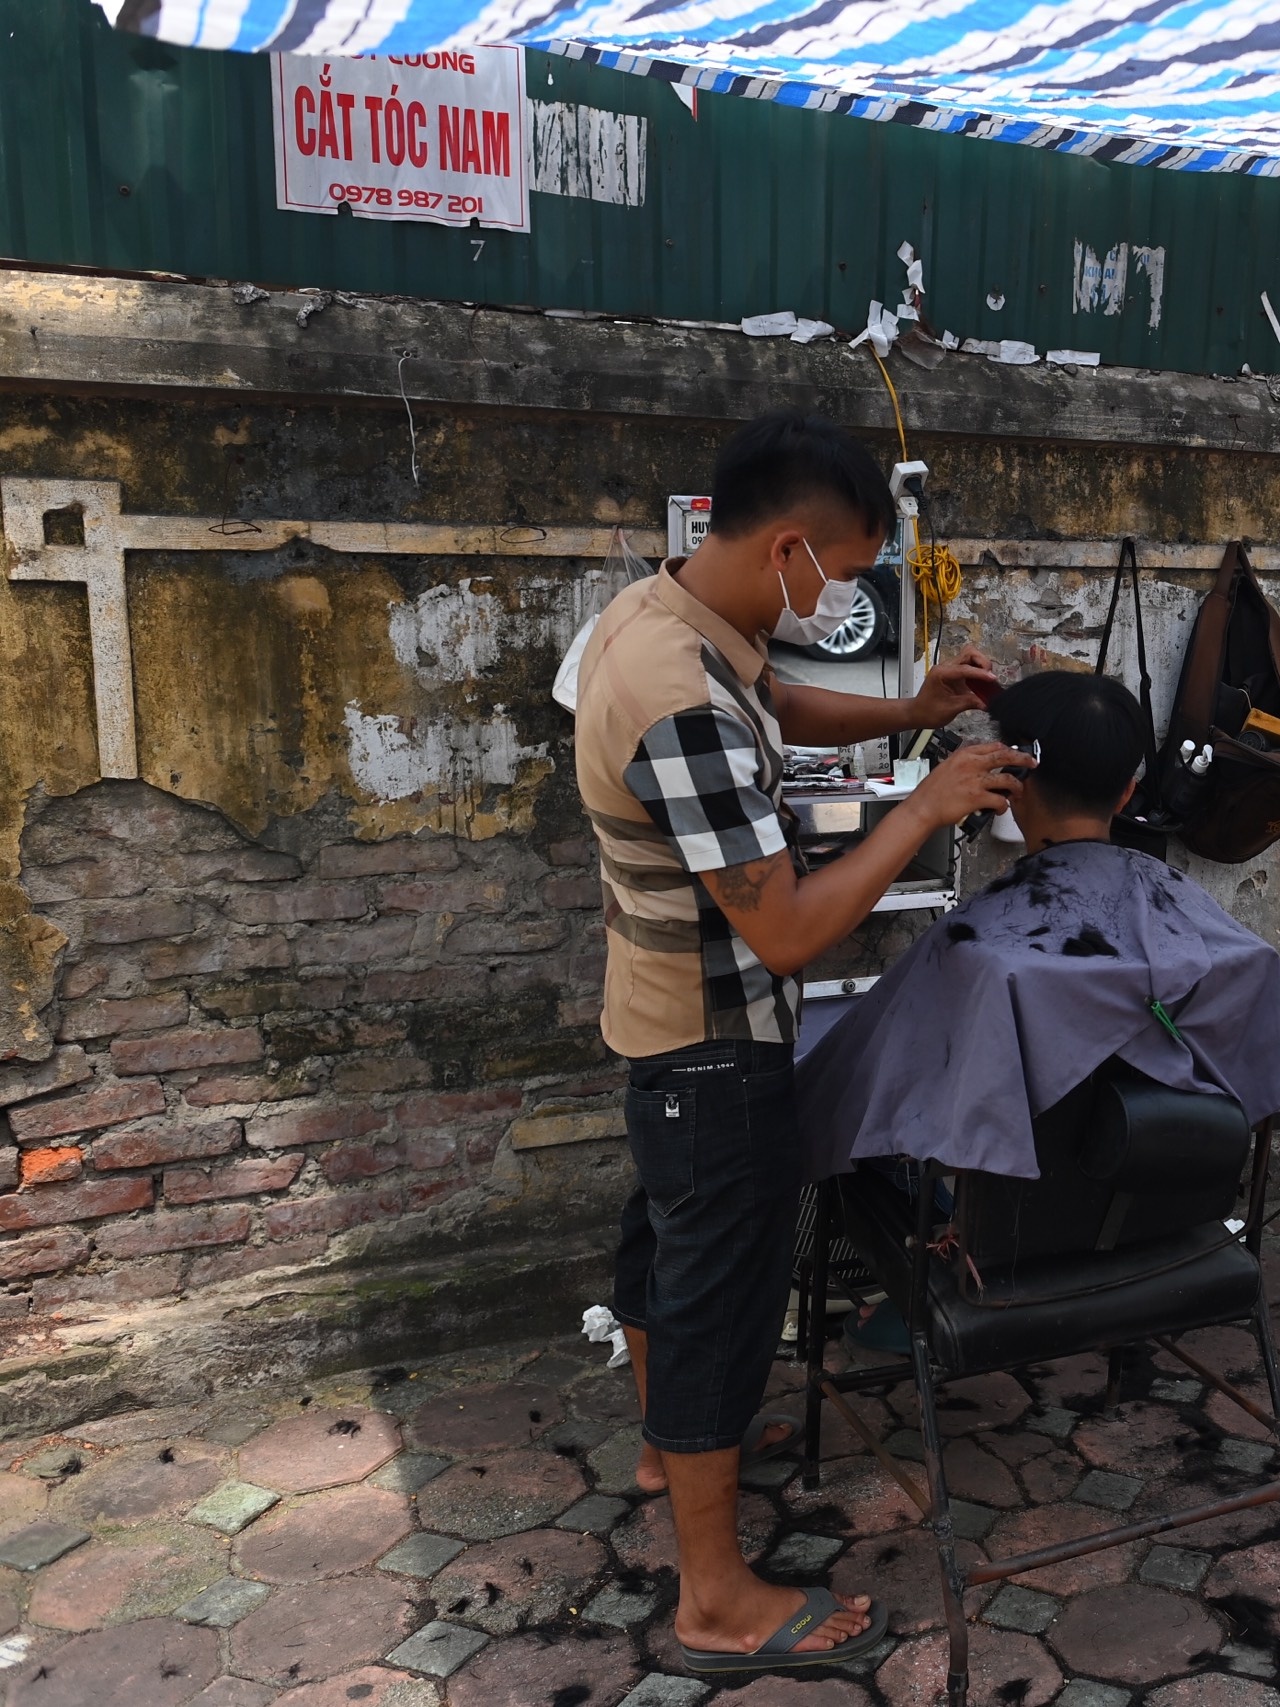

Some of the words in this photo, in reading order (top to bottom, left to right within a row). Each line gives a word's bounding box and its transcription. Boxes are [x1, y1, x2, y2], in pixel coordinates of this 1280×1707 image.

[294, 63, 356, 161] CẮT
[364, 84, 429, 168] TÓC
[438, 104, 511, 177] NAM
[328, 183, 393, 206] 0978
[397, 188, 443, 210] 987
[447, 194, 484, 213] 201
[470, 239, 486, 262] 7
